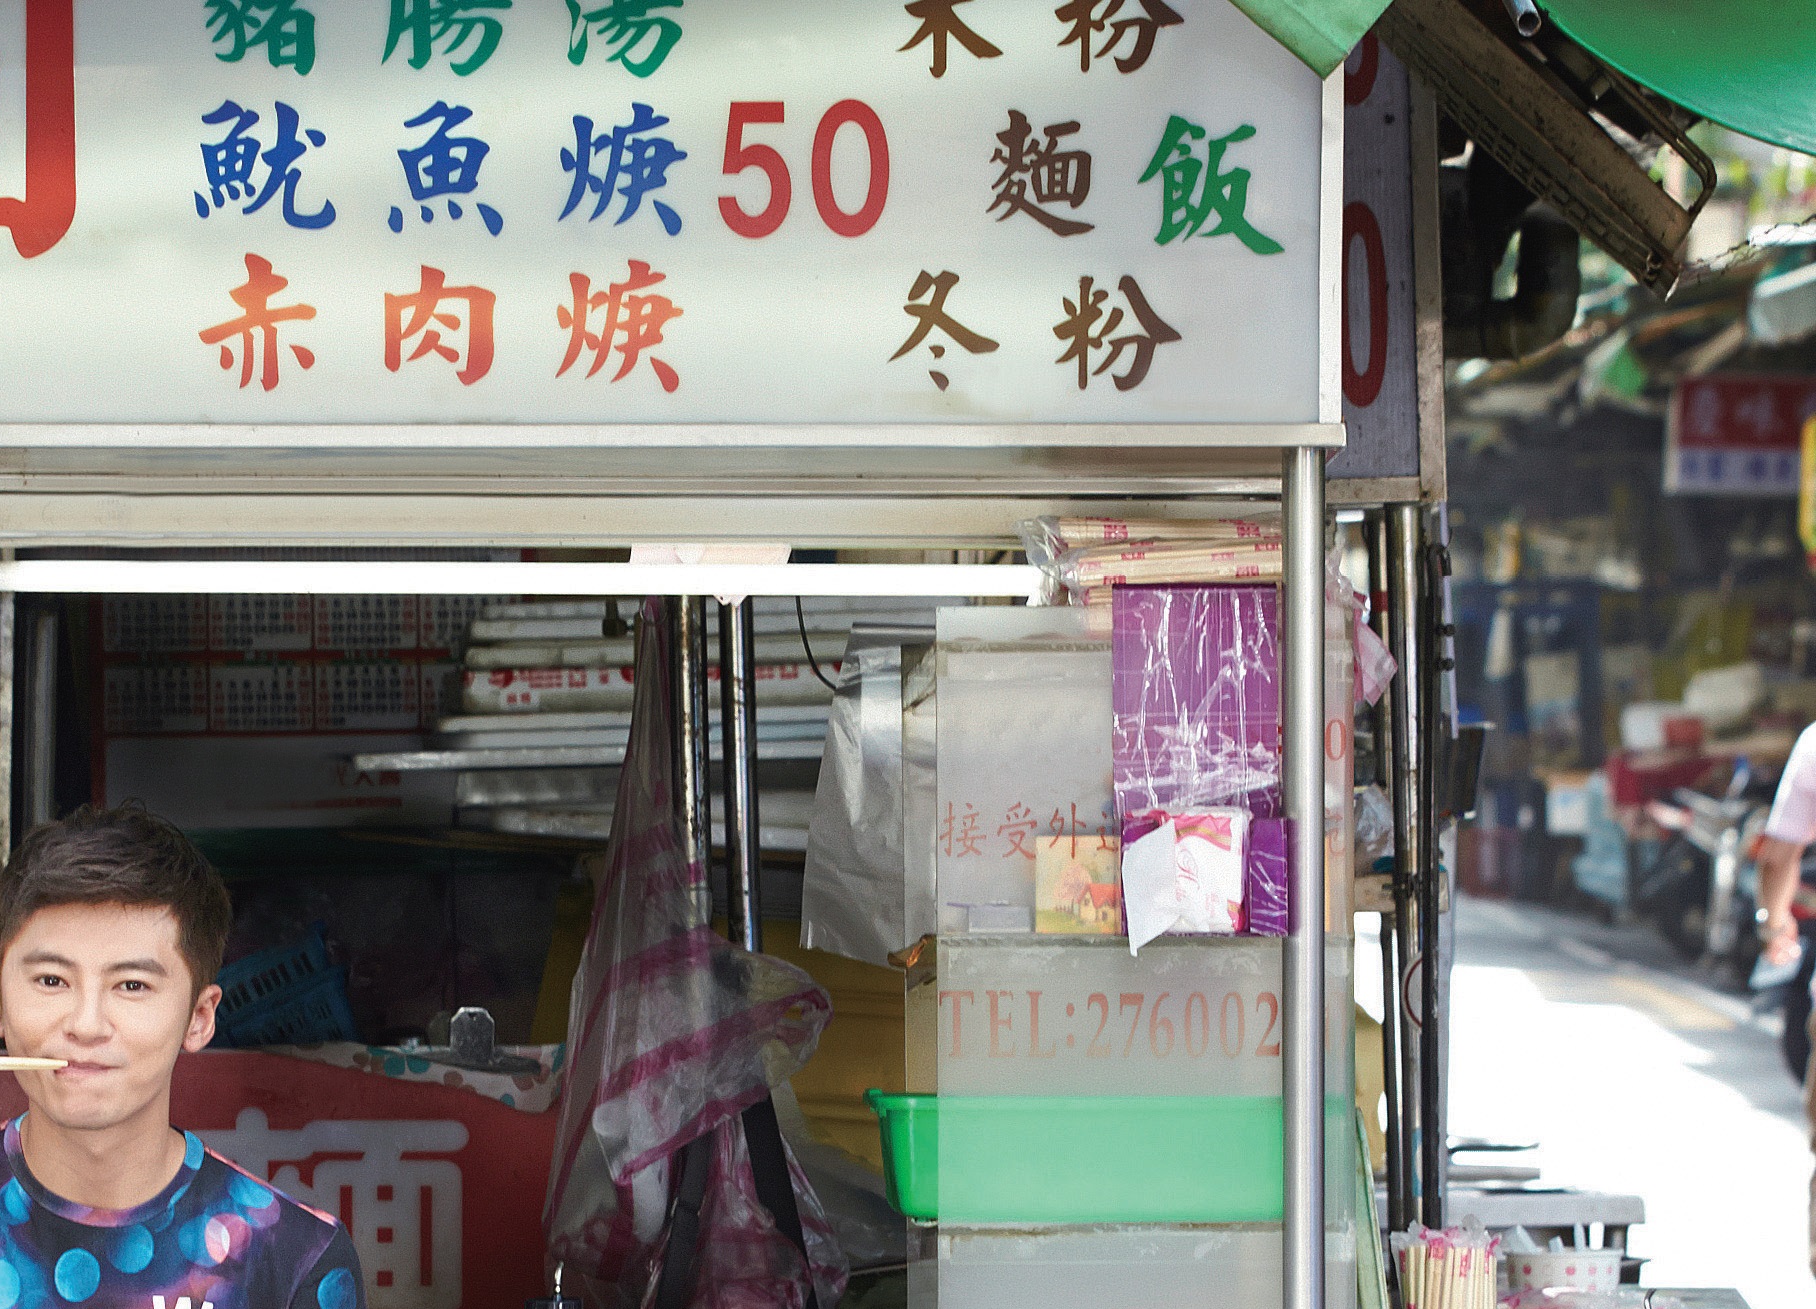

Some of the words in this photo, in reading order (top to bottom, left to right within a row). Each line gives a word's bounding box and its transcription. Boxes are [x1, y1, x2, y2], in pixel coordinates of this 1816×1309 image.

[718, 98, 890, 239] 50
[986, 109, 1095, 236] 麵
[1138, 114, 1285, 255] 飯
[198, 252, 685, 393] 赤肉焿
[888, 270, 1182, 391] 冬粉
